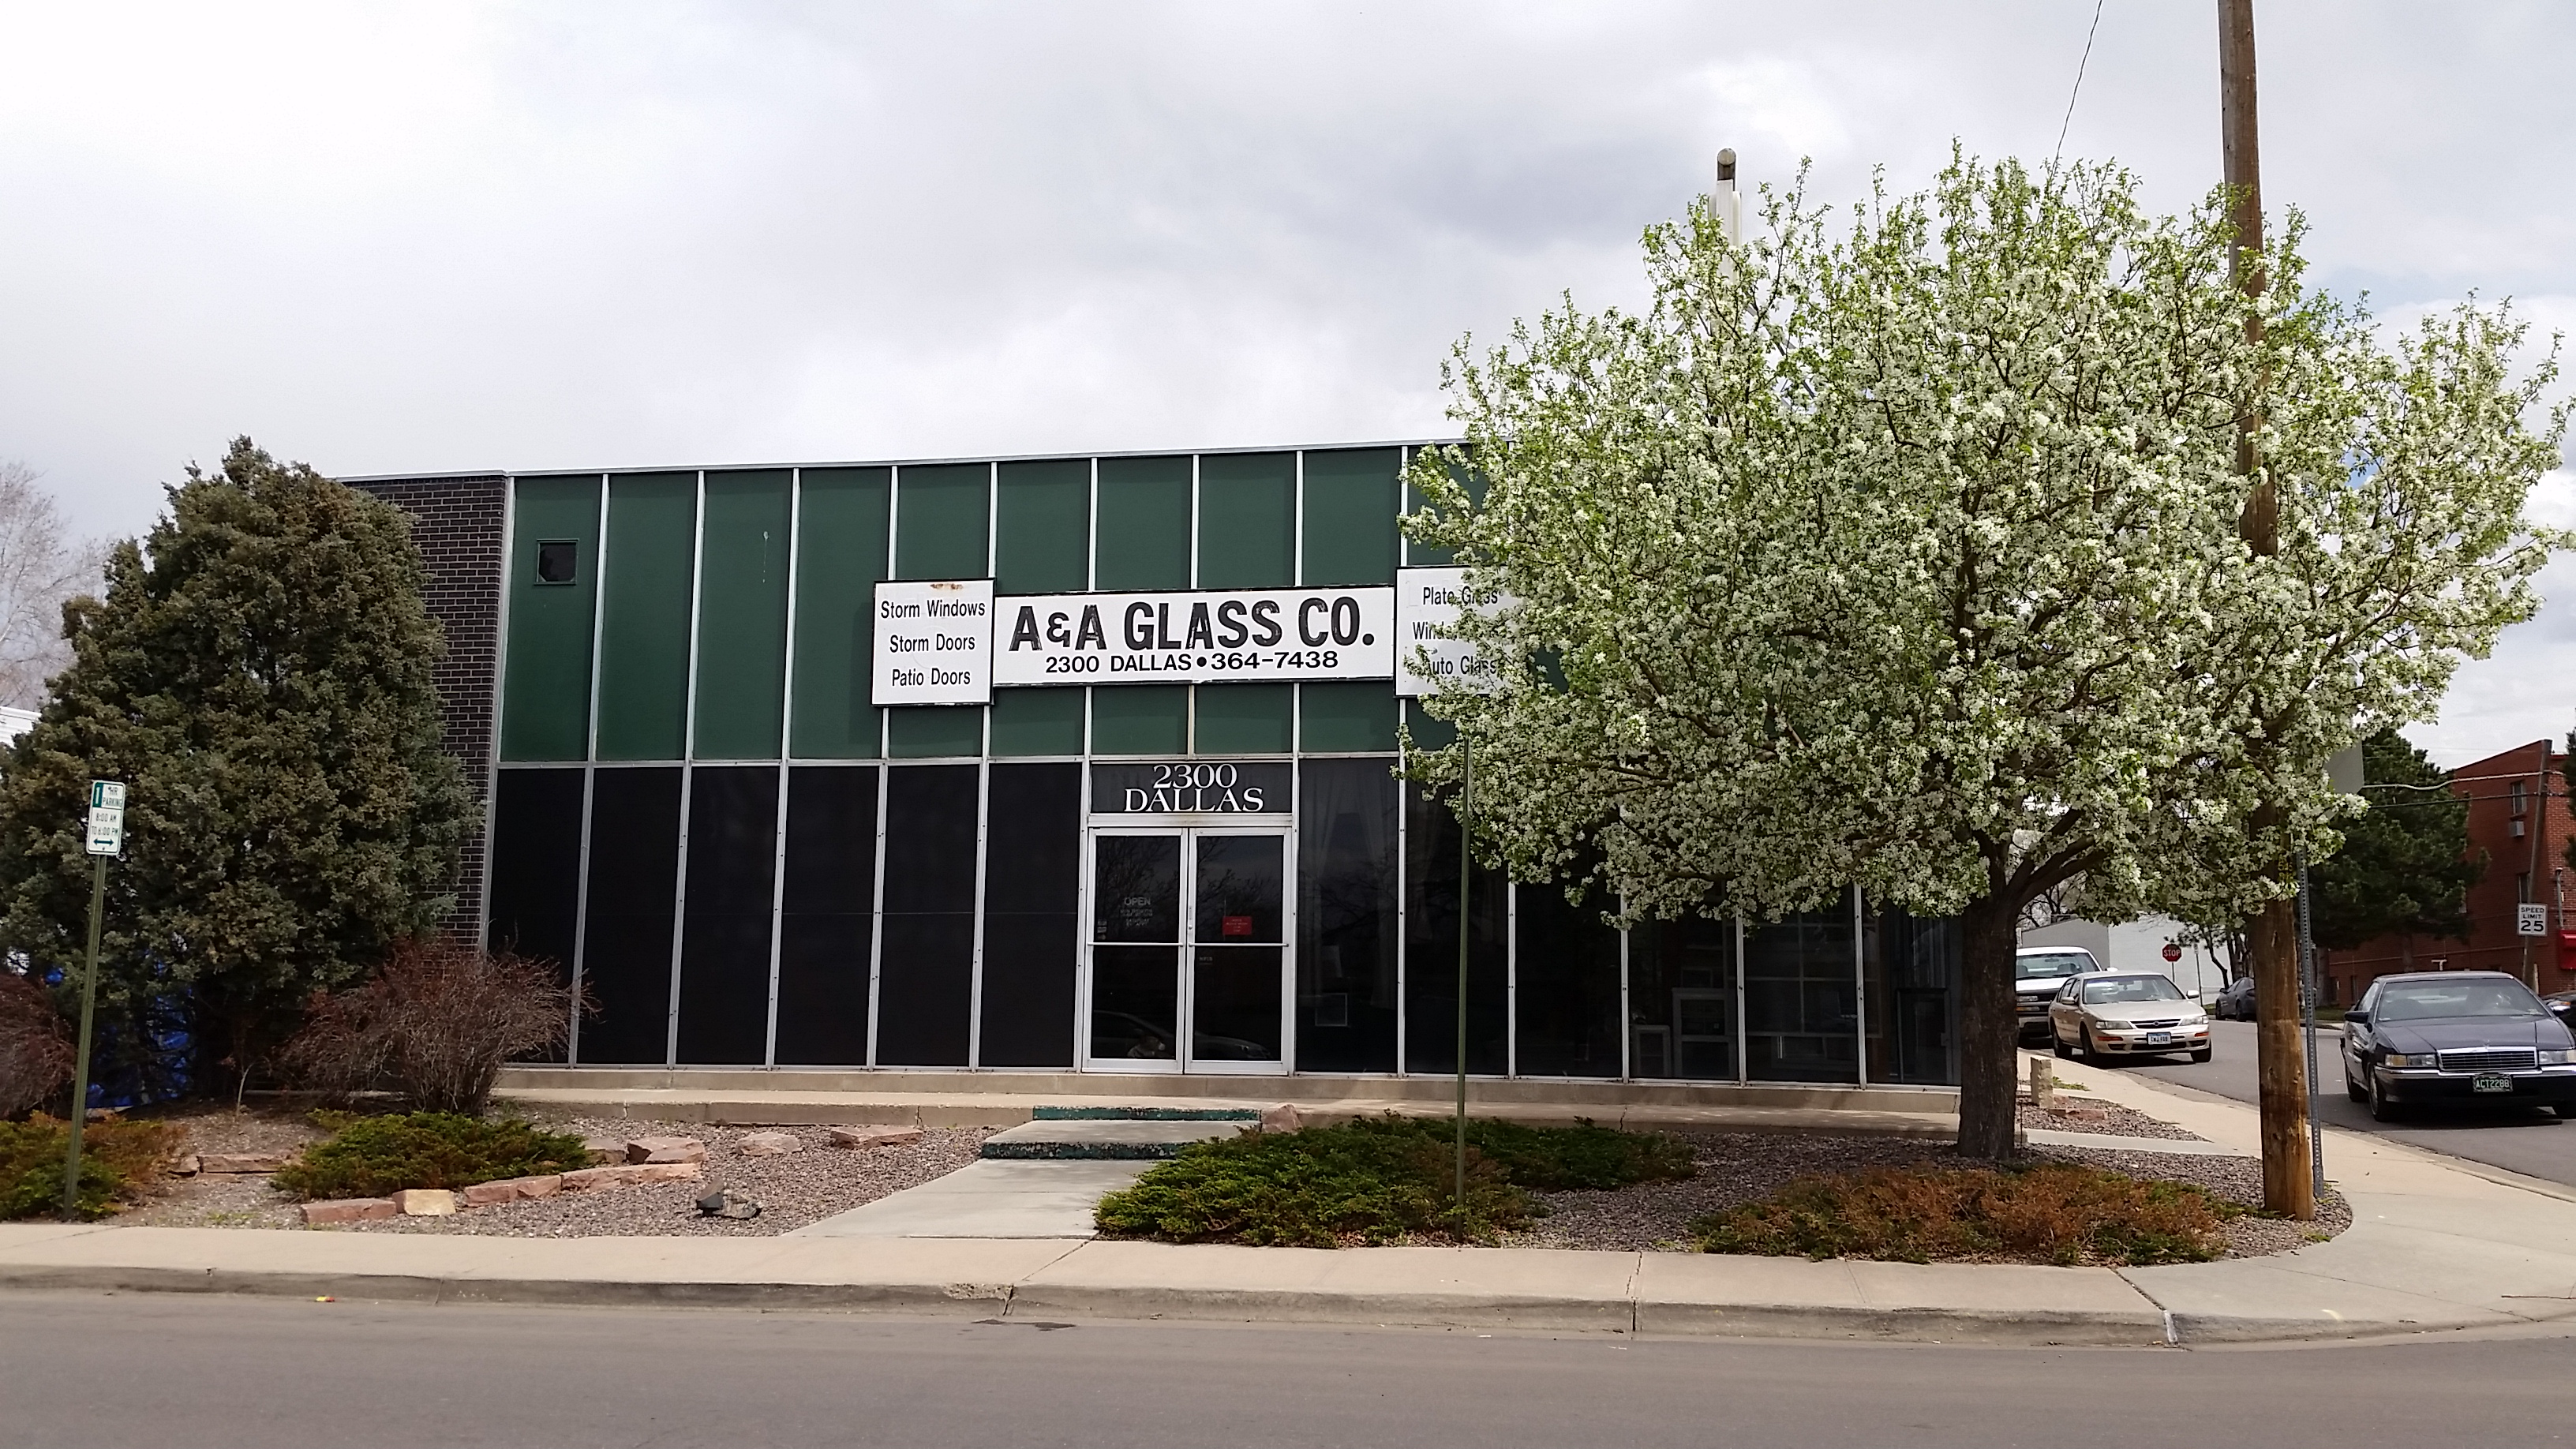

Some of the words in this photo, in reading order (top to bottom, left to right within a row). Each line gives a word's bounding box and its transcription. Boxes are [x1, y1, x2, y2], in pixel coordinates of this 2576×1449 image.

[1423, 586, 1455, 605] Plate
[1462, 586, 1498, 605] Glss
[881, 601, 920, 619] Storm
[927, 599, 986, 617] Windows
[1009, 605, 1107, 651] A&A
[1124, 600, 1282, 650] GLASS
[1298, 597, 1375, 647] CO.
[889, 635, 929, 653] Storm
[936, 633, 975, 651] Doors
[1046, 656, 1099, 673] 2300
[1110, 653, 1192, 672] DALLAS
[1211, 651, 1339, 670] 364-7438
[1424, 657, 1453, 675] uto
[892, 668, 924, 687] Patio
[931, 668, 971, 685] Doors
[1152, 763, 1237, 789] 2300
[95, 786, 100, 805] 1
[103, 796, 122, 807] PARKING
[1124, 788, 1264, 813] DALLAS
[1124, 897, 1151, 906] OPEN
[2521, 920, 2544, 932] 25
